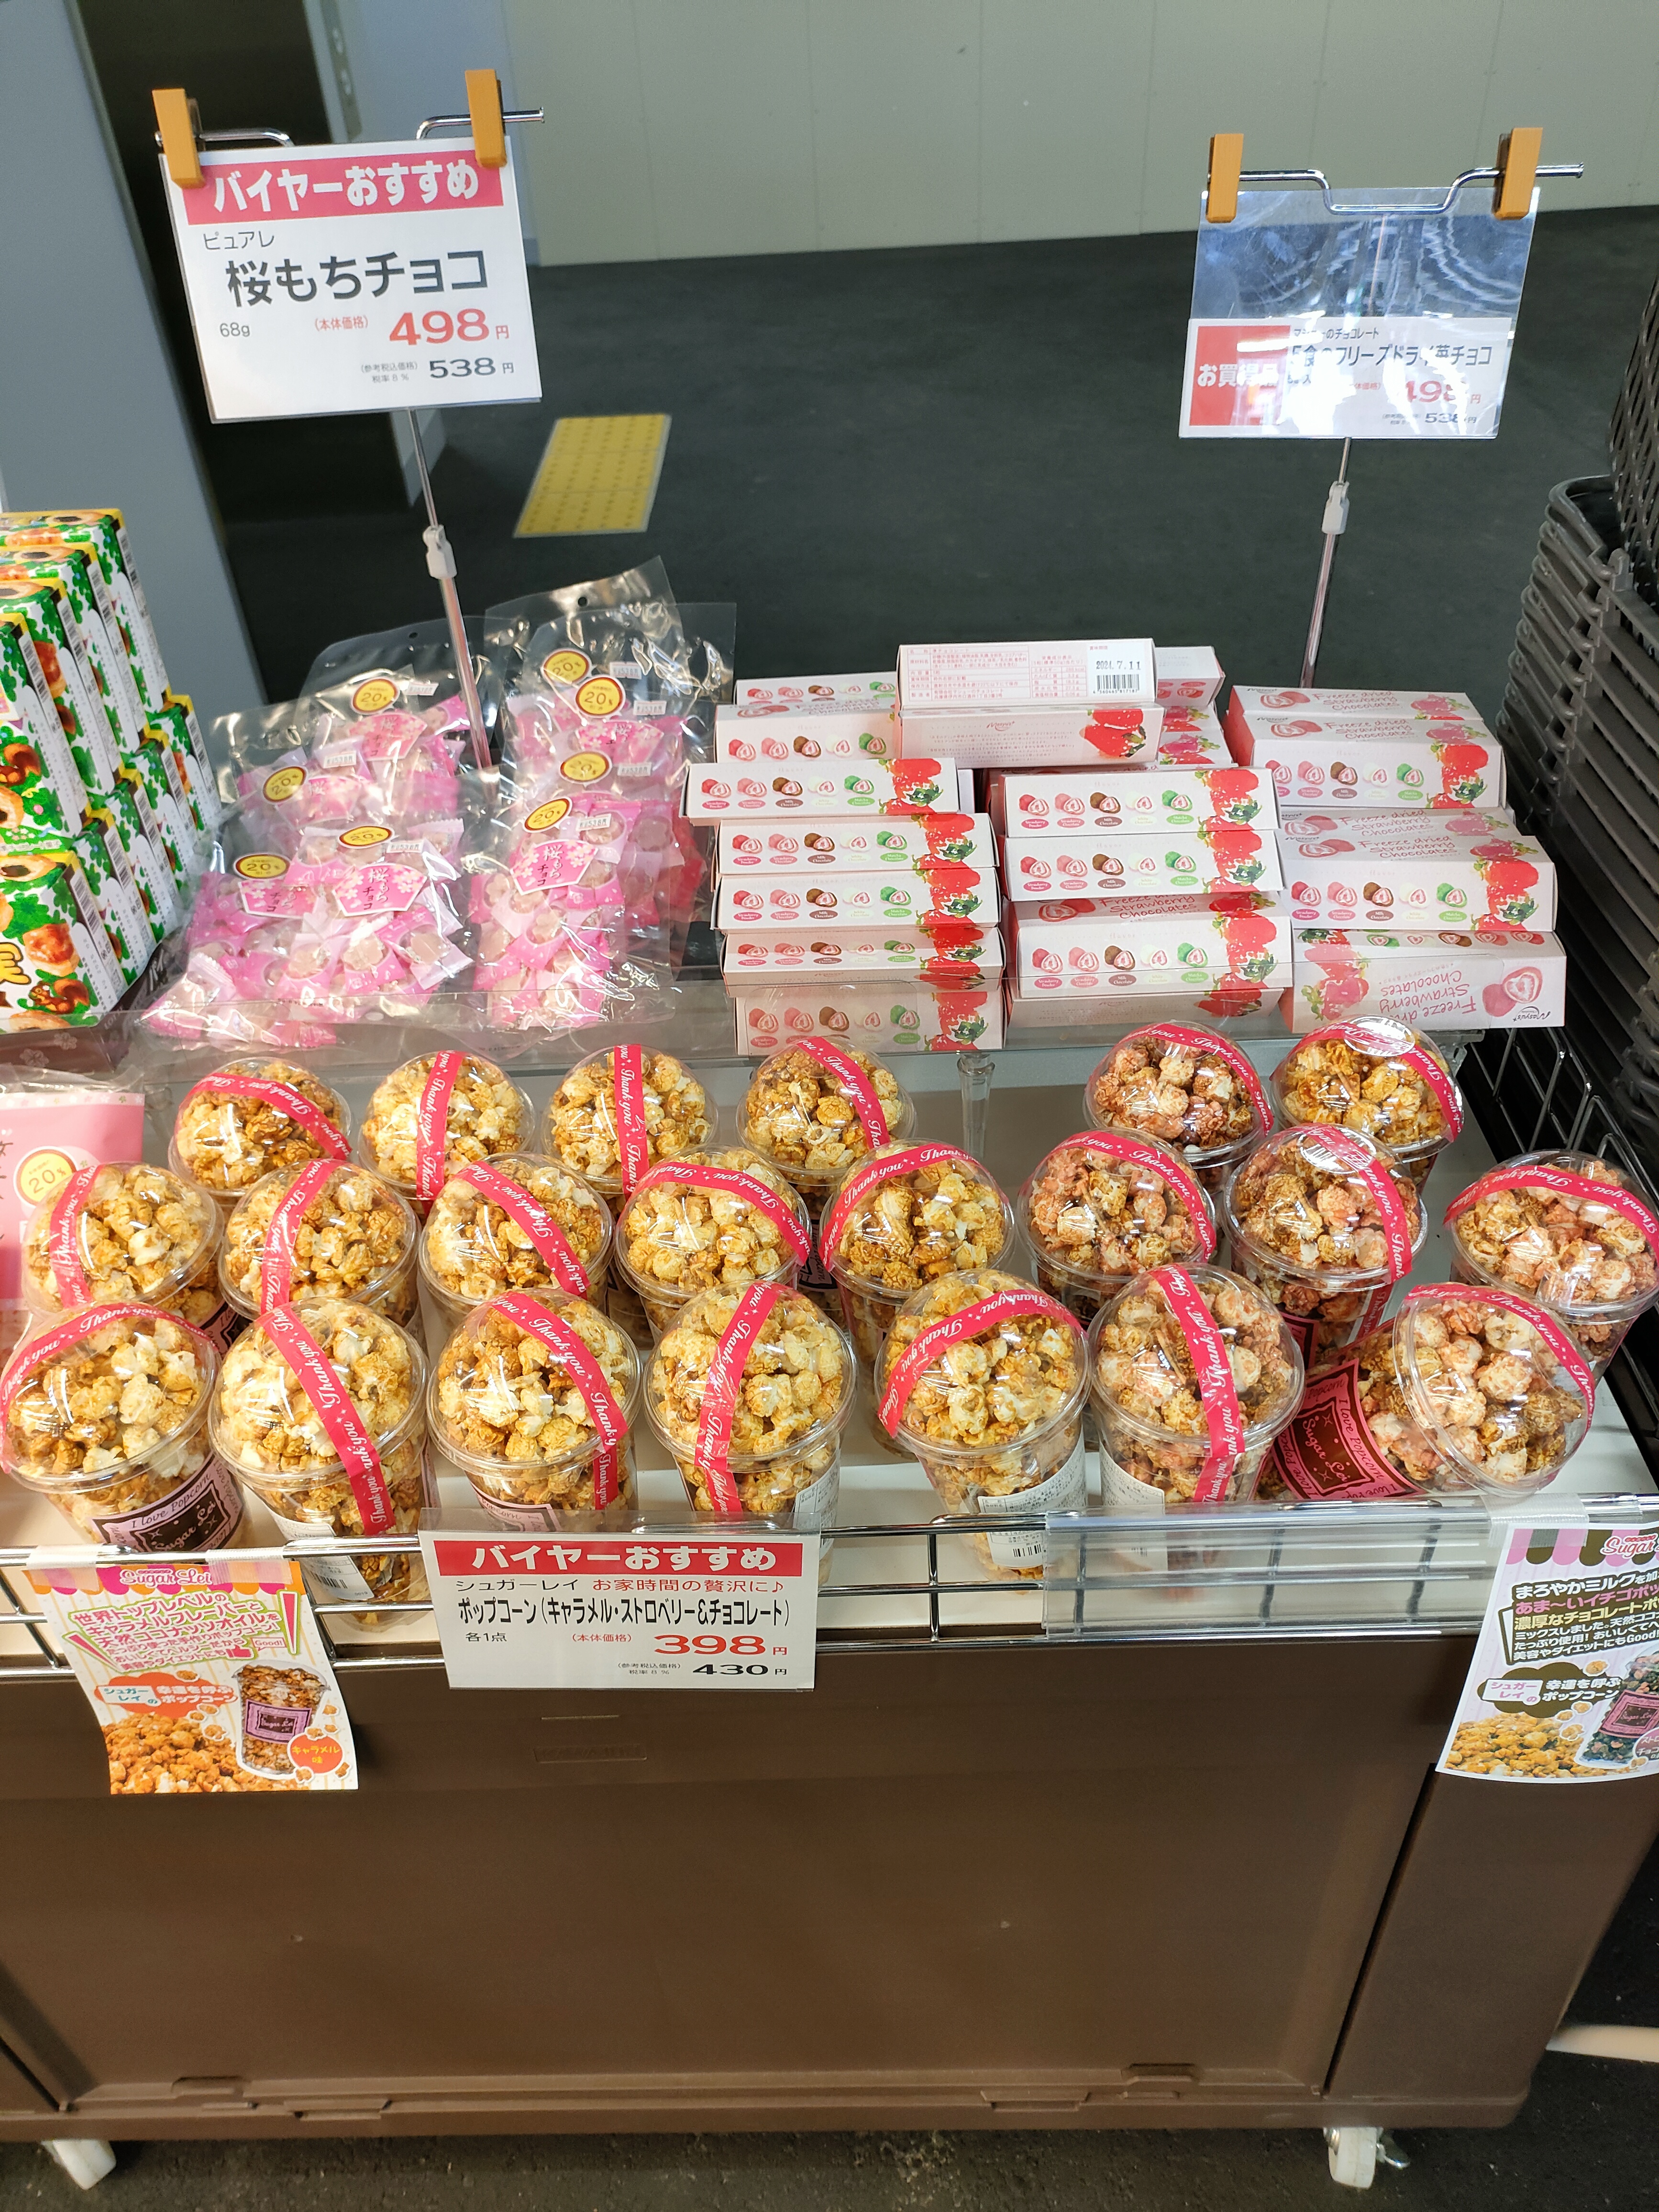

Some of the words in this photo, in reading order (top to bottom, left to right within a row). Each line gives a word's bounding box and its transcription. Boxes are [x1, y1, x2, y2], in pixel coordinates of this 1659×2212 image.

[214, 159, 478, 212] バイヤーおすすめ
[203, 231, 275, 251] ピュアレ
[225, 250, 488, 308] 桜もちチョコ
[220, 321, 251, 338] 68g
[1339, 815, 1386, 825] Freeze
[1390, 809, 1427, 818] dried
[1352, 817, 1431, 830] Strawberry
[1358, 839, 1410, 848] Freeze
[1370, 842, 1455, 853] Strawberry
[1380, 848, 1457, 858] Chocolates
[1100, 896, 1152, 907] Freeze
[1110, 896, 1195, 913] Strawberry
[1119, 903, 1197, 919] Chocolates
[1381, 970, 1461, 996] Chocolates
[1379, 984, 1470, 1014] Strawberry
[1423, 996, 1476, 1016] Freeze
[1194, 1037, 1233, 1059] Thank
[1231, 1057, 1250, 1078] you
[423, 1077, 446, 1111] Thank
[620, 1069, 634, 1098] Thank
[824, 1055, 856, 1084] Thank
[847, 1082, 866, 1106] you
[269, 1086, 313, 1115] Thank
[620, 1095, 633, 1127] you
[868, 1119, 883, 1148] Tha
[627, 1143, 642, 1184] Thank
[919, 1147, 963, 1164] Thank
[421, 1154, 439, 1196] Thank
[712, 1172, 741, 1185] you
[843, 1170, 879, 1208] Thank
[878, 1162, 905, 1179] you
[1129, 1149, 1174, 1182] Thank
[1171, 1174, 1192, 1198] you
[1518, 1168, 1572, 1186] Thank
[738, 1178, 779, 1209] Thank
[1373, 1188, 1394, 1216] you
[1591, 1185, 1626, 1198] you
[1622, 1196, 1657, 1233] Thank
[1196, 1211, 1212, 1253] Thank
[1391, 1232, 1406, 1278] Thank
[266, 1271, 281, 1313] Than
[980, 1295, 1008, 1314] you
[79, 1308, 133, 1334] Thank
[1486, 1294, 1541, 1322] Thank
[1536, 1323, 1559, 1348] you
[31, 1339, 60, 1362] you
[295, 1339, 315, 1360] you
[529, 1318, 566, 1352] Thank
[561, 1349, 586, 1377] you
[721, 1319, 751, 1364] Thank
[918, 1319, 963, 1353] Thank
[901, 1347, 924, 1373] you
[1198, 1334, 1227, 1387] Thank
[304, 1356, 341, 1408] Thank
[591, 1392, 614, 1438] Thank
[1220, 1406, 1238, 1438] you
[704, 1413, 723, 1461] Thank
[1303, 1418, 1327, 1459] Sugar
[1325, 1461, 1351, 1482] Lei
[1340, 1411, 1354, 1434] love
[1350, 1438, 1385, 1481] Popcorn
[599, 1454, 613, 1487] Thank
[142, 1510, 169, 1526] love
[171, 1472, 212, 1513] Popcorn
[369, 1493, 387, 1525] Thank
[597, 1485, 608, 1505] you
[155, 1526, 197, 1551] Sugar
[1602, 1536, 1655, 1558] Sugar
[472, 1545, 777, 1571] バイヤーおすすめ
[121, 1569, 176, 1587] Sugar
[177, 1568, 212, 1585] Lei
[456, 1578, 579, 1592] シュガーレイ
[1515, 1571, 1659, 1600] まろやかミルクを加
[74, 1592, 227, 1626] 世界トップレベルの
[87, 1601, 263, 1636] キャラメルフレーバーと
[1514, 1598, 1659, 1631] 濃厚なチョコレートポ
[99, 1612, 281, 1648] 天然ココナッツオイルを
[465, 1632, 507, 1642] 各1点
[1515, 1611, 1659, 1641] ミックスしました。天然ココ
[103, 1686, 149, 1695] シュガー
[160, 1694, 237, 1704] ポップコーン
[1490, 1681, 1538, 1690] シュガー
[1542, 1689, 1620, 1702] ポップコーン
[292, 1745, 340, 1755] キャラメル
